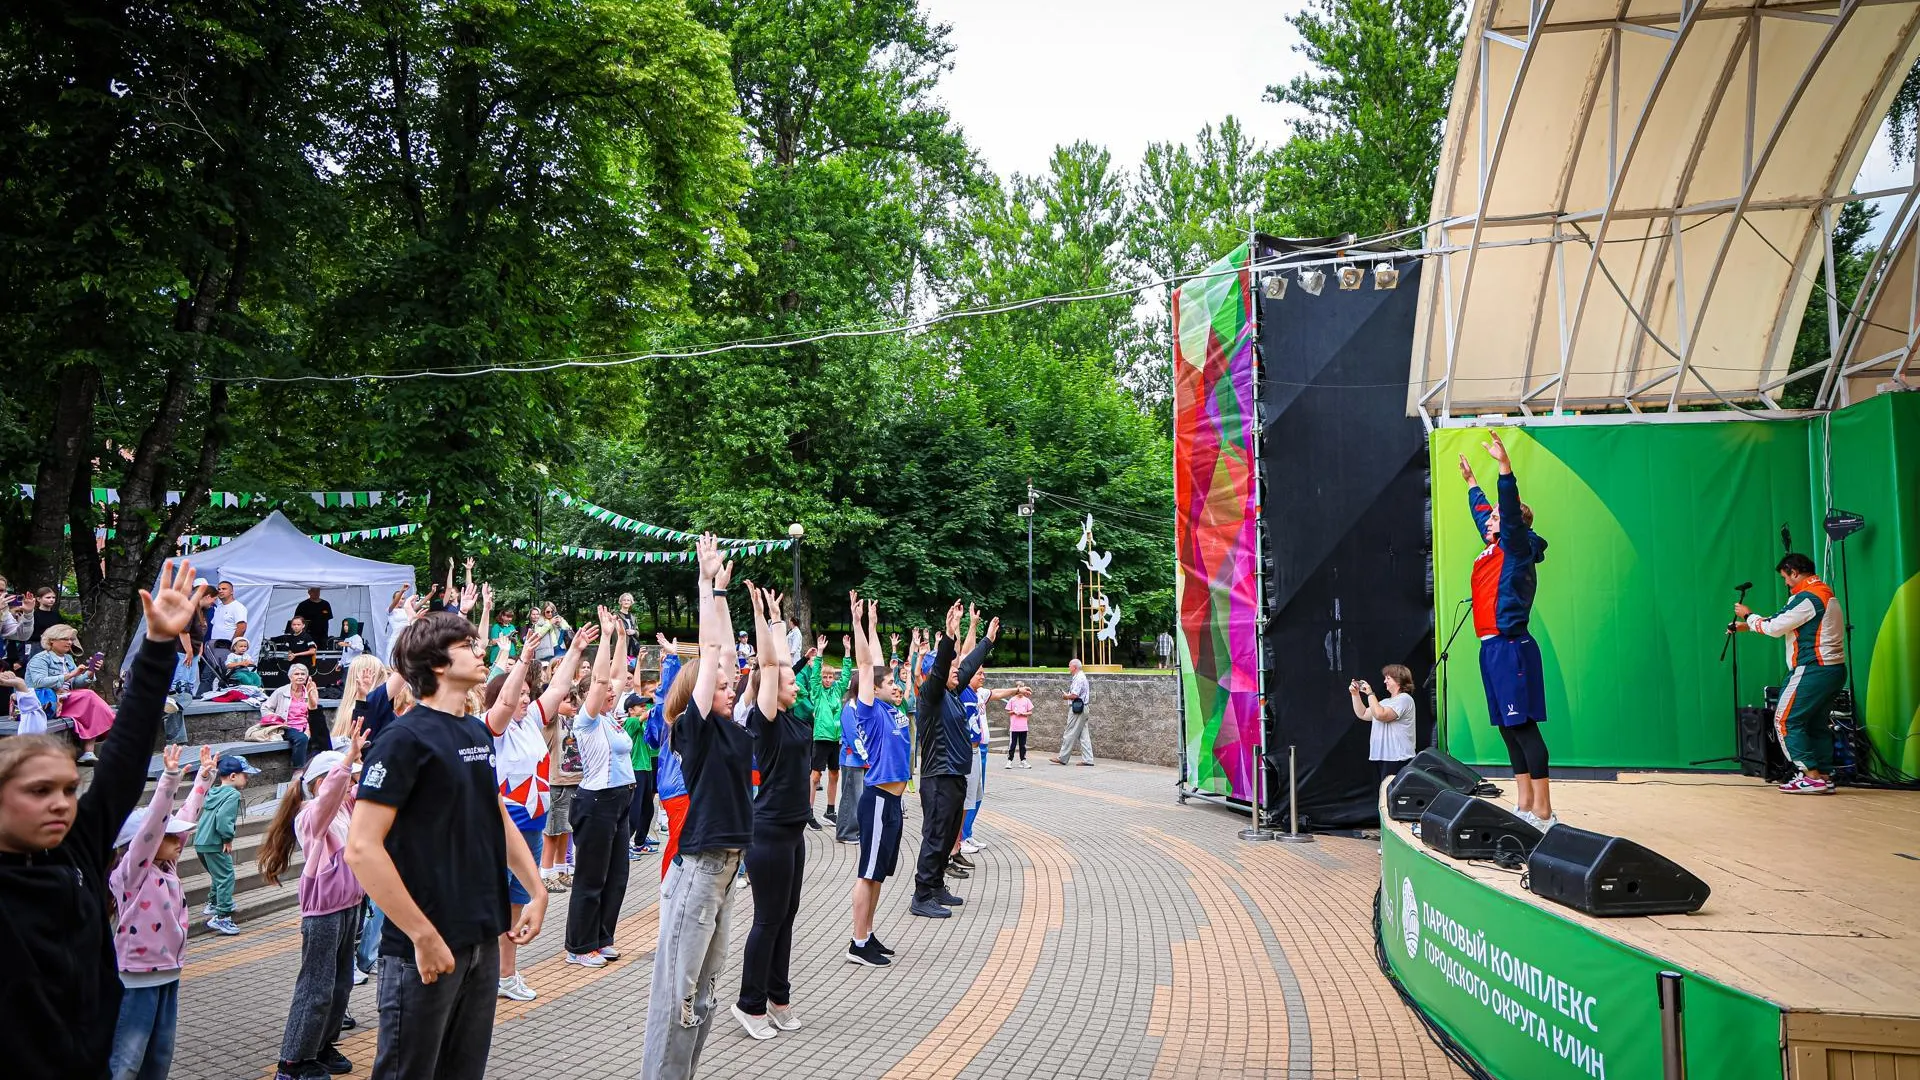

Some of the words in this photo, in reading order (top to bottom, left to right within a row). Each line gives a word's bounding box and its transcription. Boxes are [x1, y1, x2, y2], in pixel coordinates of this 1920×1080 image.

[1422, 901, 1487, 968] ПАРКОВЫЙ
[1490, 943, 1599, 1033] КОМПЛЕКС
[1424, 938, 1490, 1006] ГОРОДСКОГО
[1491, 988, 1550, 1048] ОКРУГА
[1552, 1025, 1606, 1080] КЛИН
